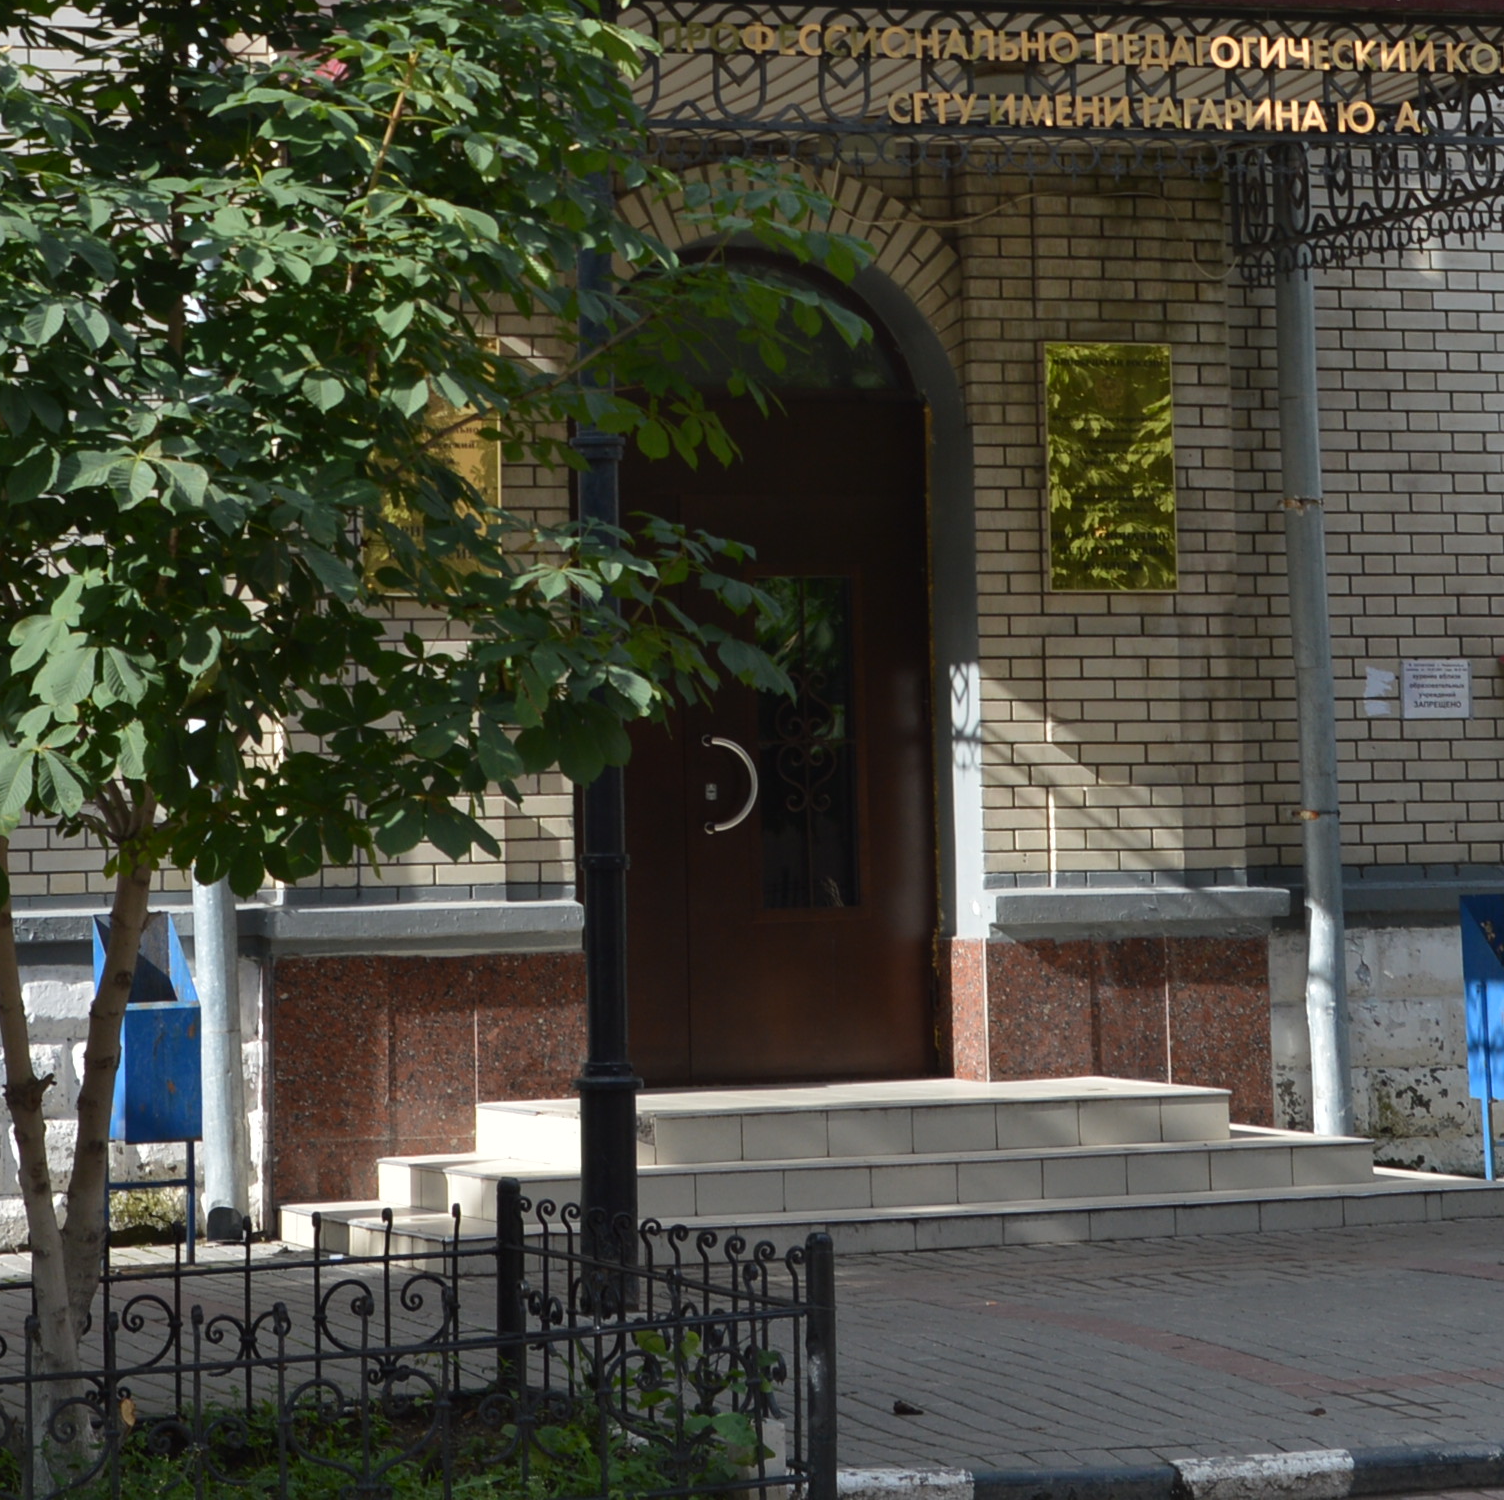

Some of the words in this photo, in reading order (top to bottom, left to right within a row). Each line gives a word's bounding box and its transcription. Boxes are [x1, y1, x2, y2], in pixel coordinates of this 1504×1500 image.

[887, 92, 978, 125] СГТУ
[989, 93, 1131, 128] ИМЕНИ
[1143, 97, 1328, 132] ГАГАРИНА
[1413, 700, 1462, 709] ЗАПРЕЩЕНО
